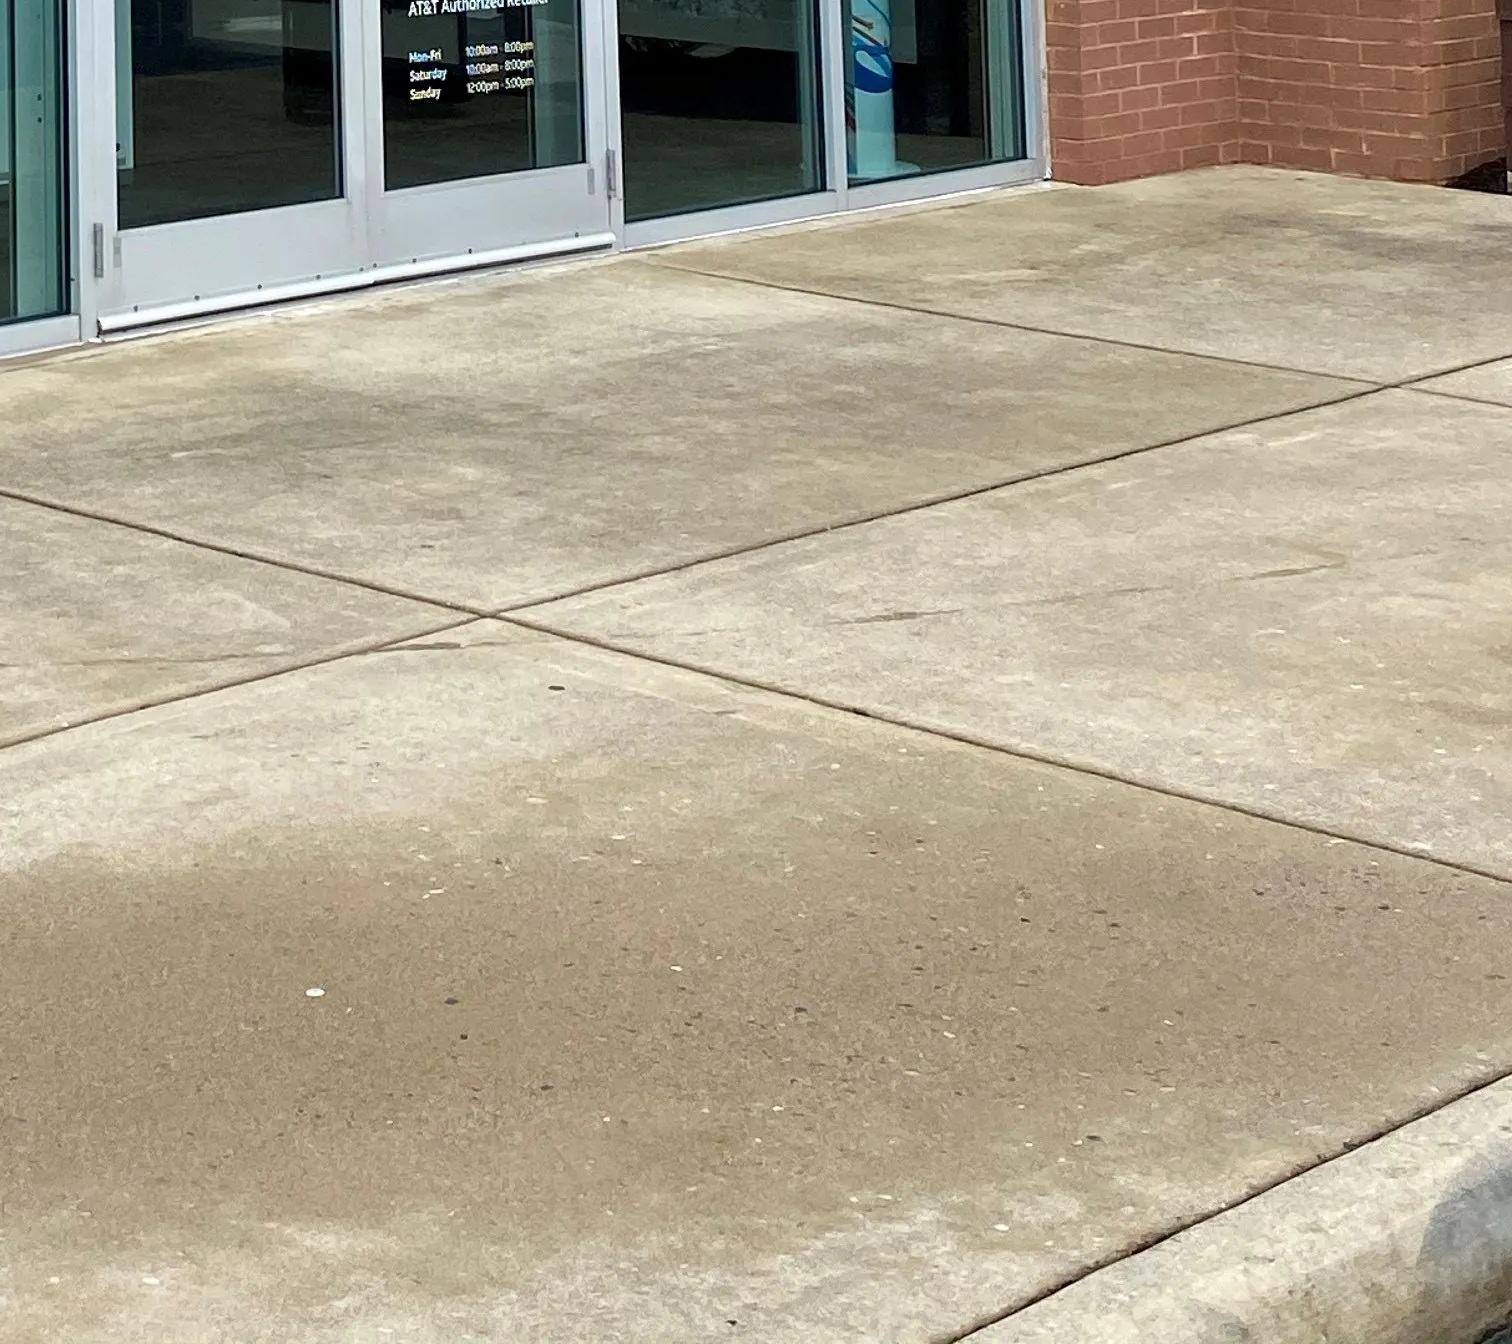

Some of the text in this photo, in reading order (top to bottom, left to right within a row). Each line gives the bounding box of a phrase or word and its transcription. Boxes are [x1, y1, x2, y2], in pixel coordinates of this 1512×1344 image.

[408, 48, 442, 63] Mon-Fri
[409, 68, 448, 82] Saturday
[409, 86, 442, 101] Sunday
